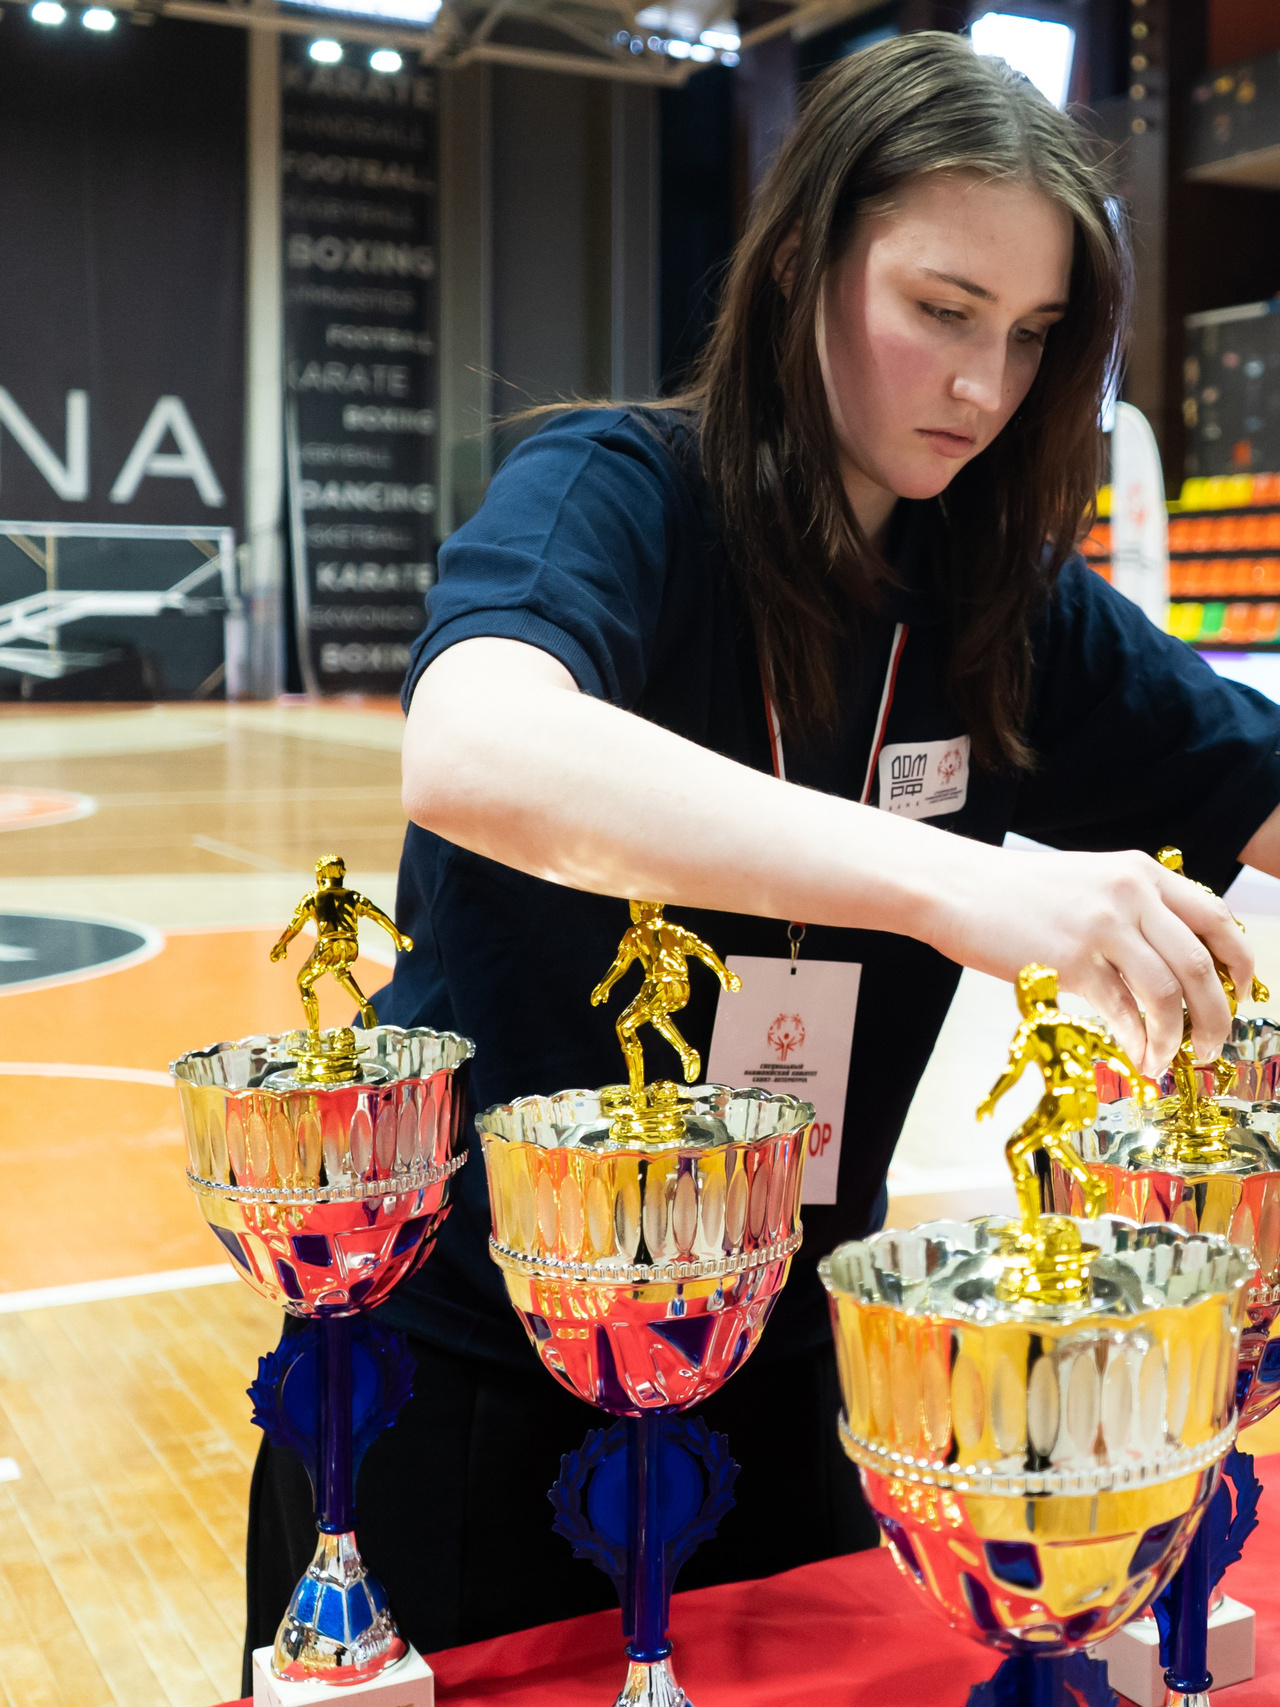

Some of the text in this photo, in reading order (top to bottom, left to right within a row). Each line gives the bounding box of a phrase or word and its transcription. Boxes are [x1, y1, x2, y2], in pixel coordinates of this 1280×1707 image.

[288, 232, 434, 279] BOXING
[342, 404, 435, 435] BOXING
[300, 479, 435, 514] DANCING
[316, 561, 434, 593] KARATE
[320, 643, 411, 673] BOXIN
[808, 1122, 833, 1158] ОР
